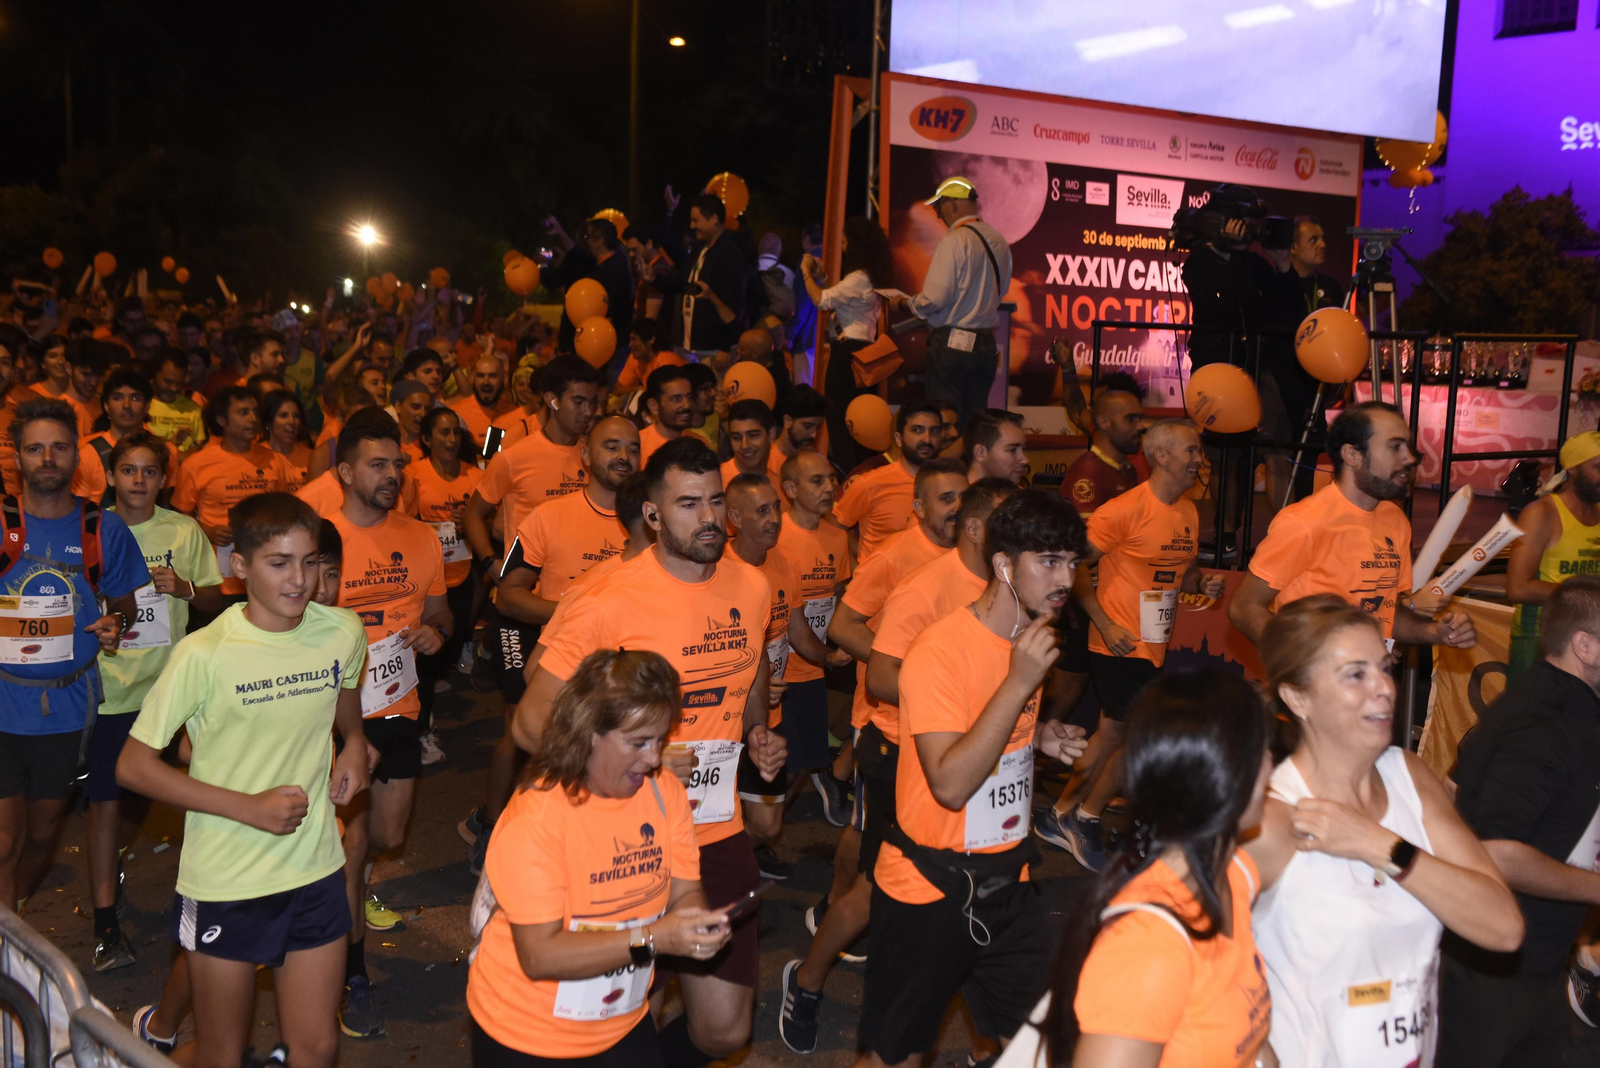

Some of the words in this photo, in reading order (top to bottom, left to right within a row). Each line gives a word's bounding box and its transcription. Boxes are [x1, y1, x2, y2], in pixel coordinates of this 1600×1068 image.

[991, 115, 1019, 132] ABC
[1033, 123, 1090, 146] Cruzcampo
[1100, 134, 1125, 147] TORRE
[1126, 137, 1157, 151] SEVILLA
[1065, 180, 1080, 190] IMD
[1083, 229, 1097, 244] 30
[1098, 231, 1113, 246] de
[1045, 253, 1126, 289] XXXIV
[1045, 294, 1193, 335] NOCTUR
[1045, 463, 1067, 475] IMD
[364, 566, 409, 577] NOCTURNA
[1360, 560, 1389, 569] SEVILLA
[344, 577, 385, 589] SEVILLA
[19, 619, 49, 636] 760
[703, 628, 747, 642] NOCTURNA
[508, 629, 524, 669] SURCO
[682, 641, 726, 656] SEVILLA
[368, 655, 403, 683] 7268
[235, 679, 273, 694] MAURI
[276, 669, 330, 687] CASTILLO
[242, 694, 274, 706] Escuela
[276, 692, 285, 700] de
[287, 686, 324, 698] Atletismo
[690, 766, 721, 789] 946
[989, 777, 1030, 809] 15376
[612, 846, 663, 867] NOCTURNA
[589, 866, 637, 886] SEVILLA
